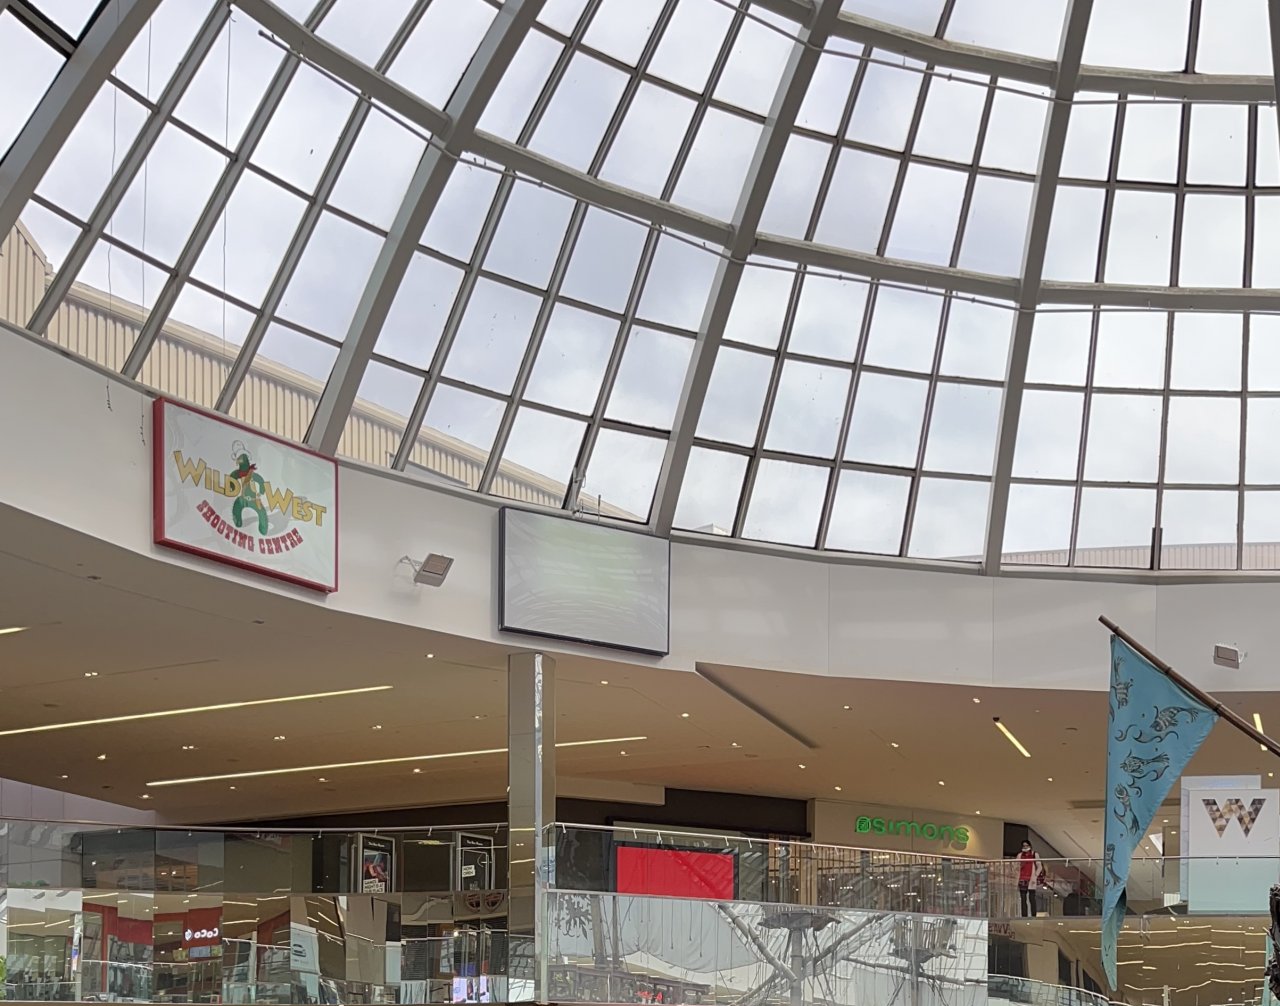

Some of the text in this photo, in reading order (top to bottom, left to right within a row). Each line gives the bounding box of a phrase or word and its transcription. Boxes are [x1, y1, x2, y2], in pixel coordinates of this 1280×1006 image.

[173, 450, 327, 527] WILD WEST
[196, 500, 304, 555] SHOOTING CENTRE
[871, 817, 970, 844] simons
